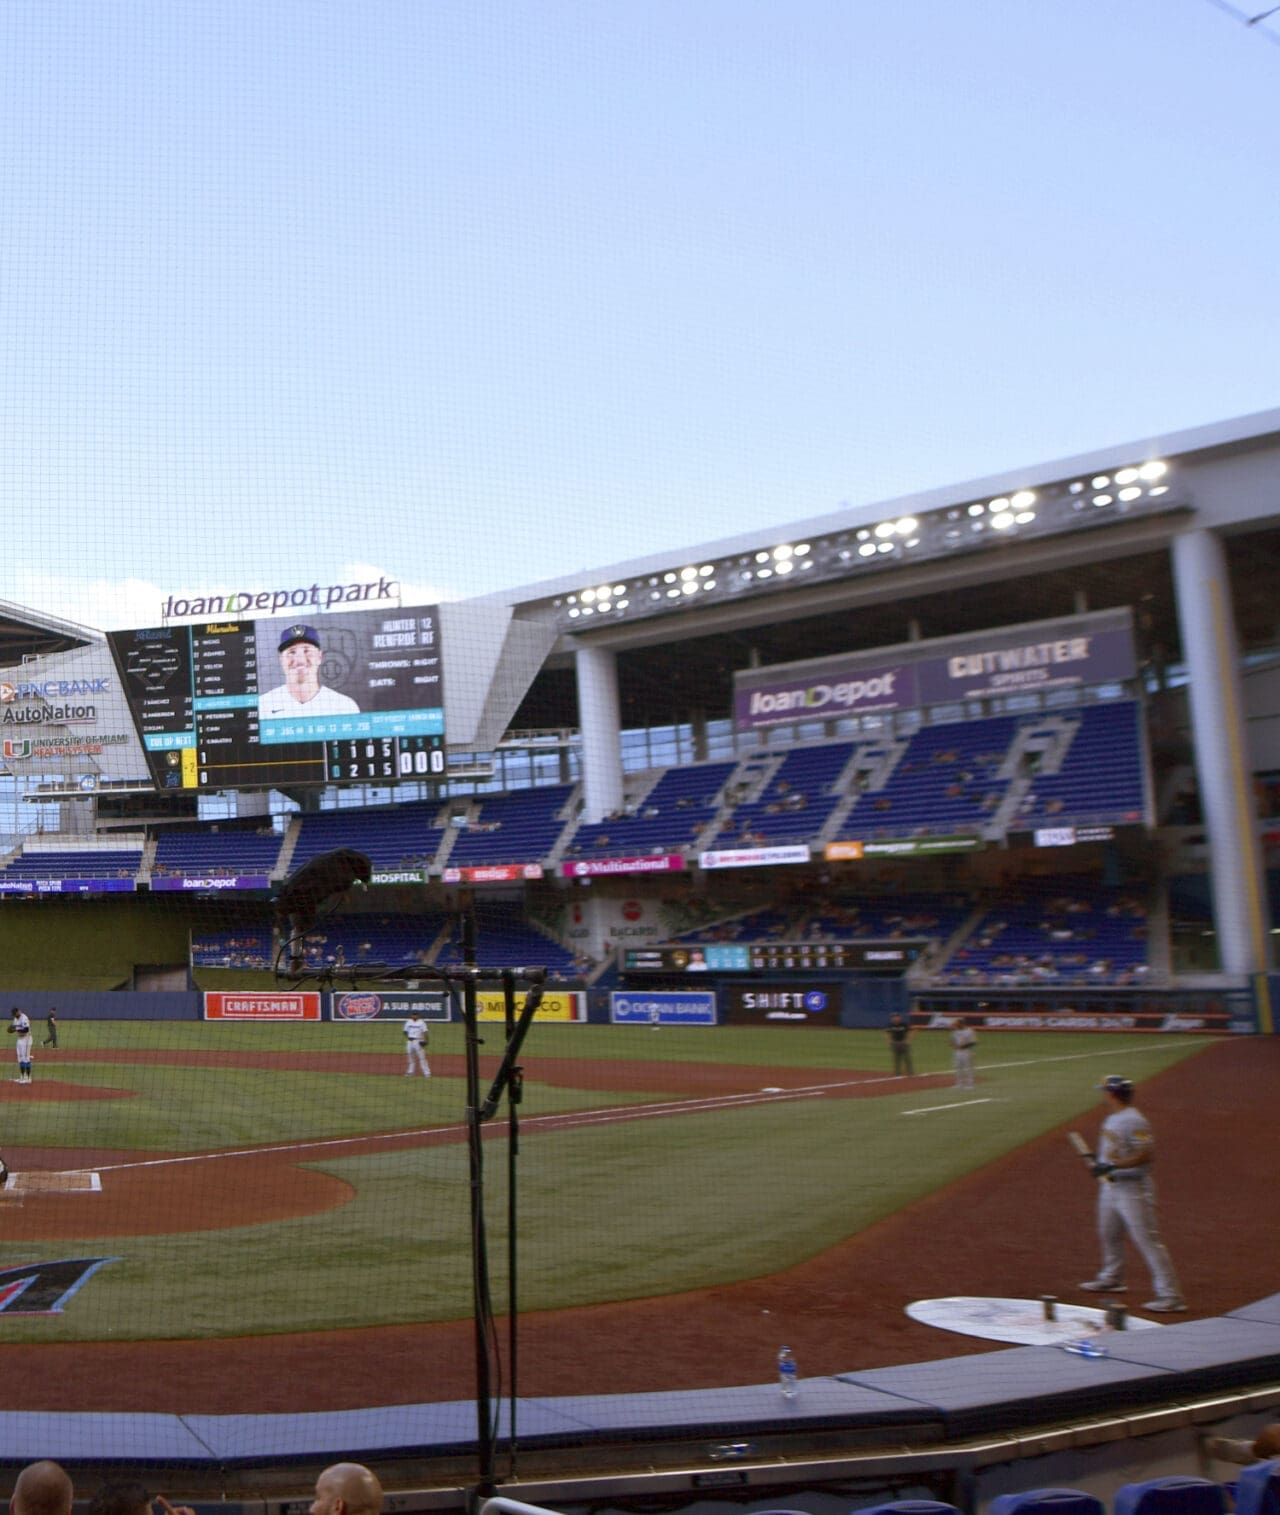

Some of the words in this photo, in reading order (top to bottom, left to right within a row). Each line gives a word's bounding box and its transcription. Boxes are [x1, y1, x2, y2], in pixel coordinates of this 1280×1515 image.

[166, 583, 320, 618] loanDepot
[326, 577, 393, 609] park
[948, 637, 1090, 679] CUTWATER
[750, 672, 896, 715] loanDepot
[3, 704, 95, 722] AutoNation
[34, 735, 83, 747] UNIVERSITY
[98, 734, 128, 744] MIAMI
[590, 857, 669, 873] Multinational
[183, 878, 237, 889] loanDepot
[371, 873, 423, 883] HOSPITAL
[226, 1001, 297, 1011] CRAFTSMAN
[391, 1002, 409, 1010] SUB
[411, 1002, 442, 1011] ABOVE
